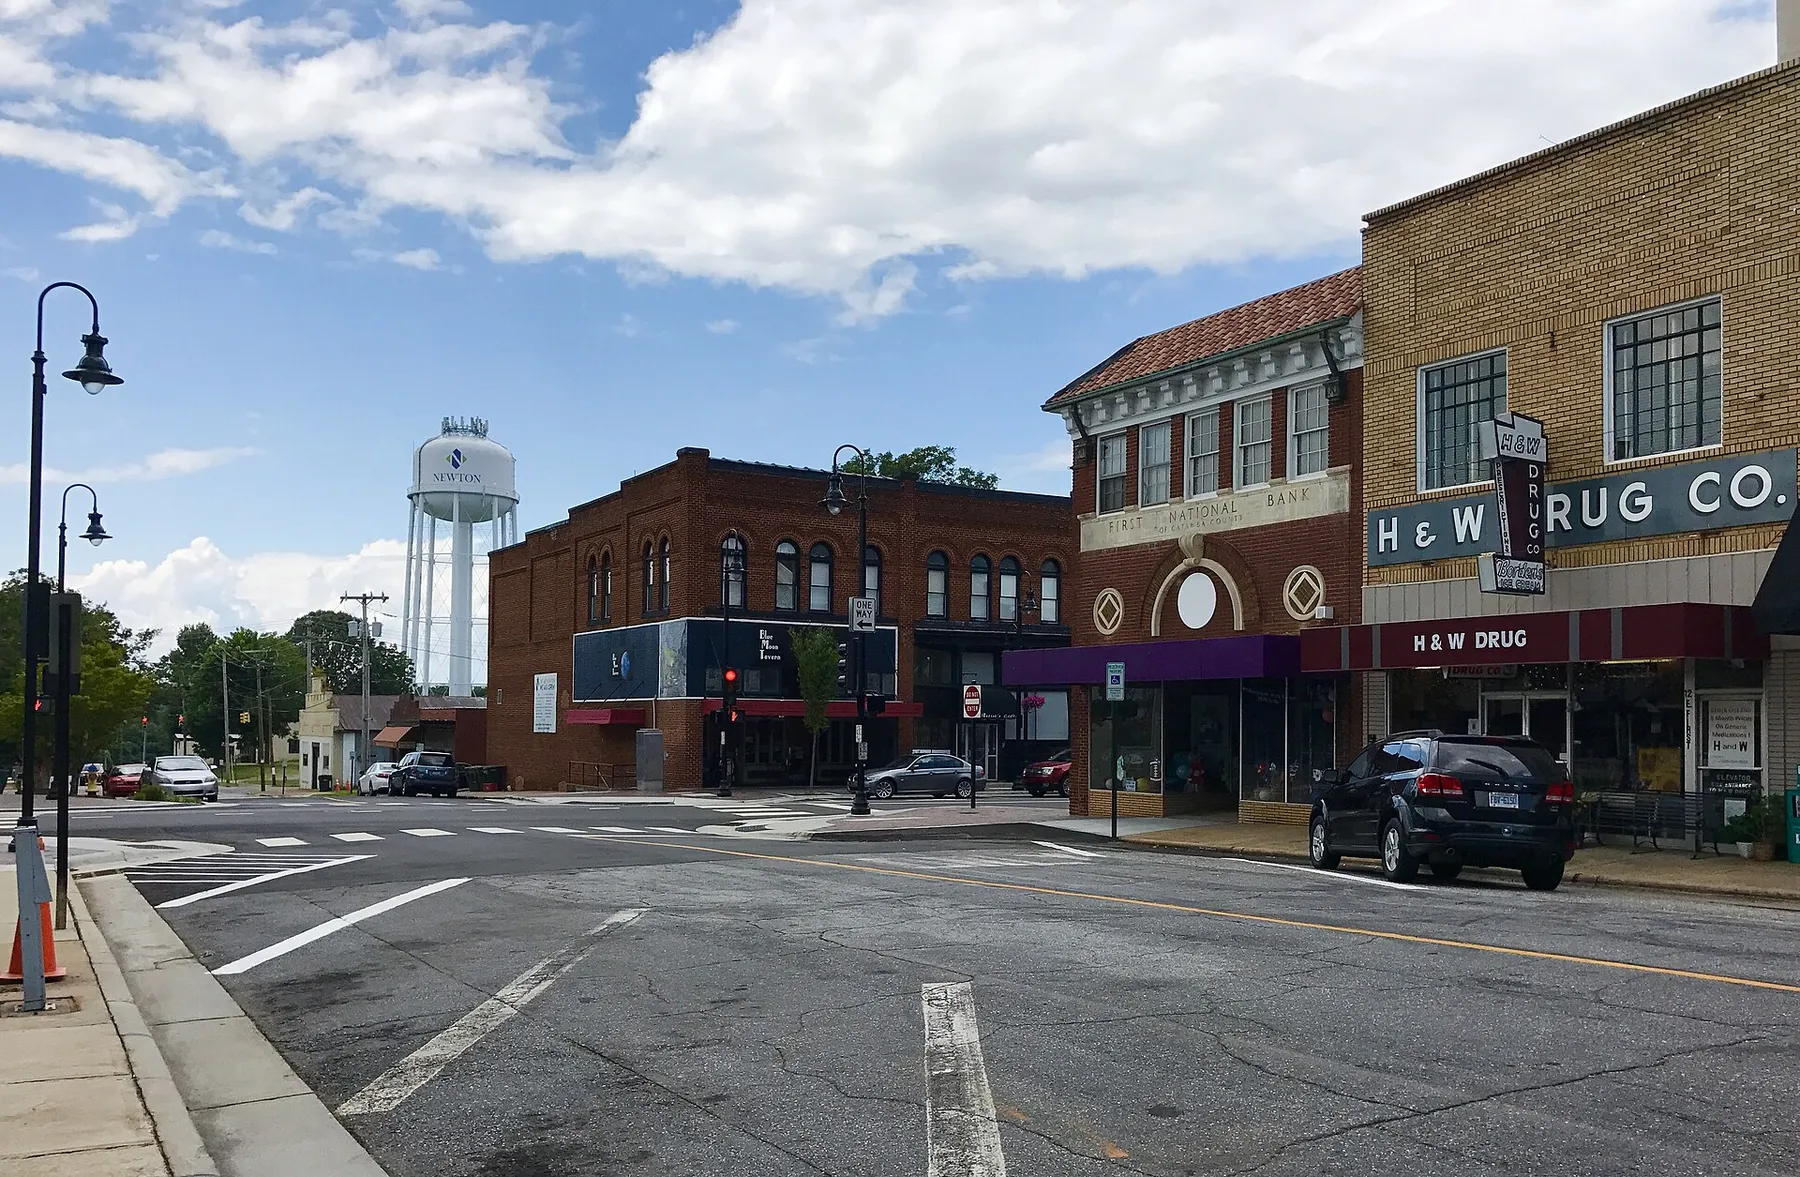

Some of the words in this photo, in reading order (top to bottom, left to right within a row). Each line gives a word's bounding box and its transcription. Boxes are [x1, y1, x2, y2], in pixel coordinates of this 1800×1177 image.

[433, 473, 481, 483] NEWTON
[1528, 464, 1541, 539] DRUG
[1108, 517, 1144, 534] FIRST
[1169, 500, 1239, 524] NATIONAL
[1267, 487, 1311, 508] BANK
[1377, 516, 1399, 554] H
[1415, 522, 1437, 548] &
[1452, 503, 1485, 544] W
[1546, 481, 1654, 533] RUG
[1688, 464, 1788, 515] CO.
[1495, 462, 1511, 554] PRESCRIPTIONS
[1158, 526, 1168, 534] OF
[856, 601, 873, 609] ONE
[856, 610, 873, 618] WAY
[761, 640, 779, 650] Moon
[1414, 635, 1425, 652] H
[1430, 633, 1443, 651] &
[1447, 633, 1466, 650] W
[1475, 629, 1527, 649] DRUG
[760, 649, 781, 660] Tavern
[1452, 666, 1484, 675] DRUG
[1713, 740, 1721, 751] H
[1723, 741, 1736, 750] and
[1739, 741, 1748, 752] W
[1716, 774, 1751, 782] ELEVATOR
